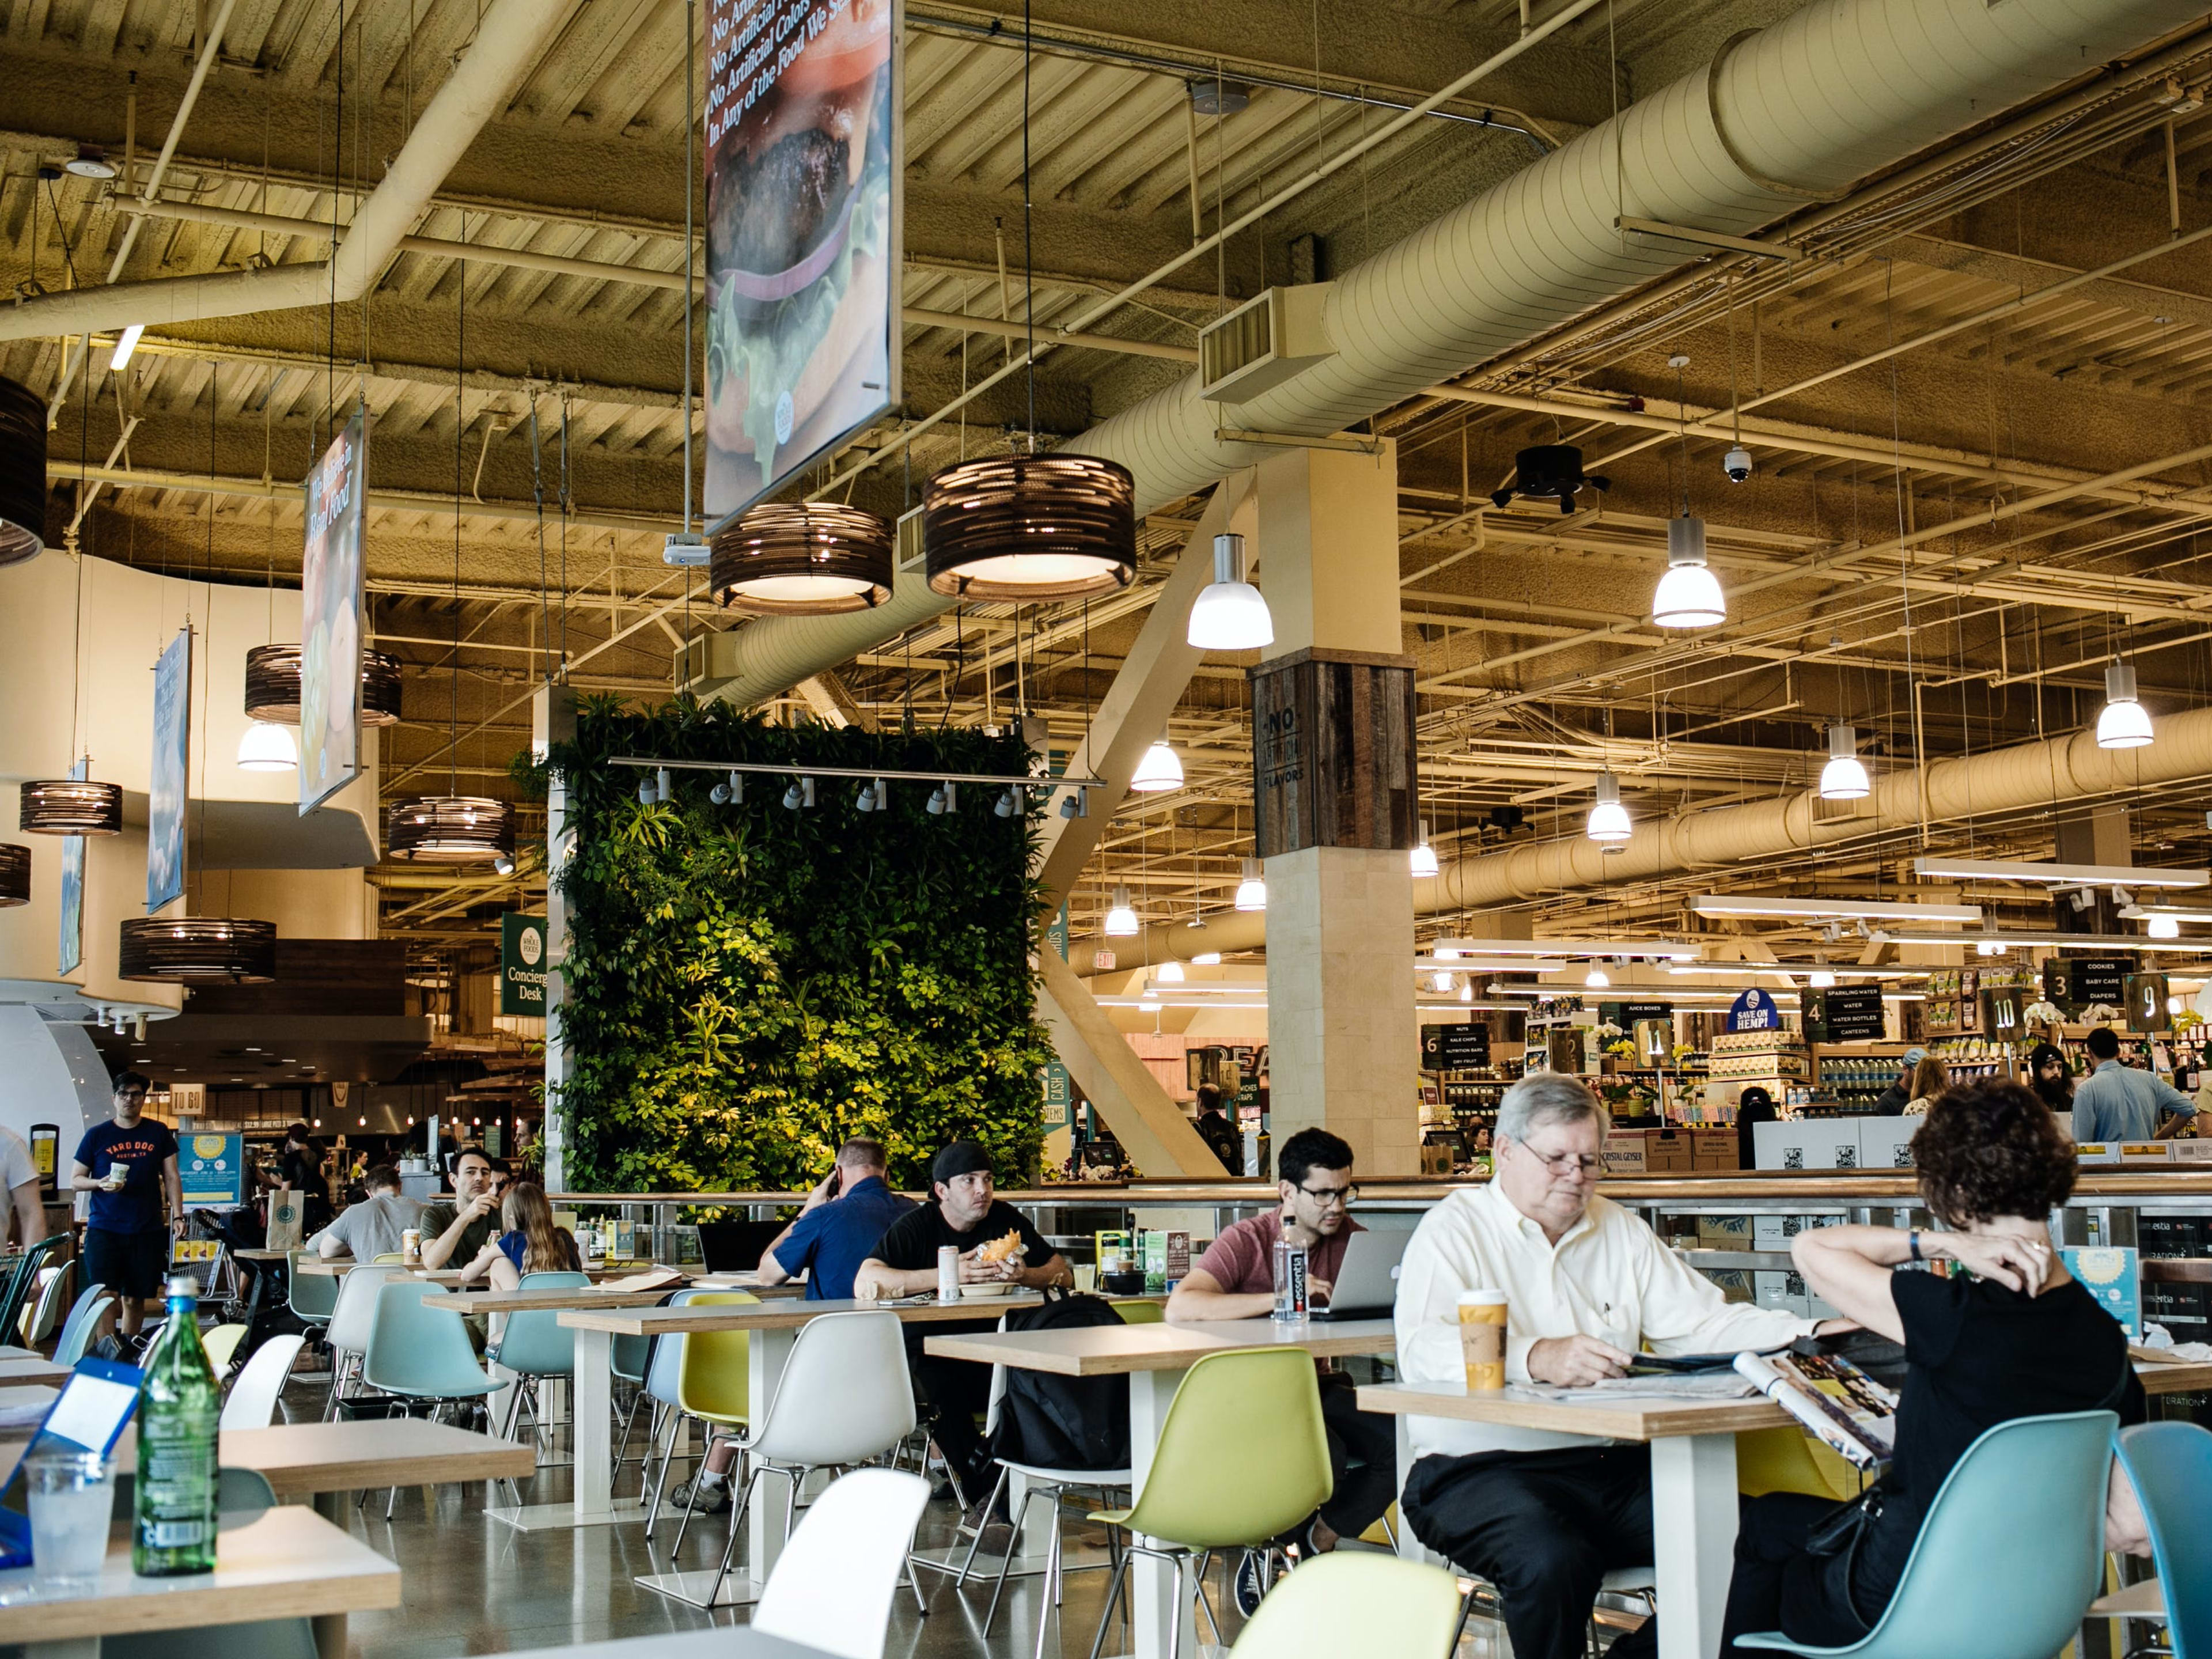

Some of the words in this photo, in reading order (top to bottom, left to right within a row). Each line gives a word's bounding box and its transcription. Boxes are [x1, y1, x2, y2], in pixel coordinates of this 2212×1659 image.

[710, 50, 727, 81] No
[728, 0, 775, 63] Artificial
[711, 17, 729, 47] No
[710, 84, 725, 114] No
[726, 26, 774, 96] Artificial
[775, 0, 810, 43] Colors
[710, 122, 720, 148] In
[721, 98, 744, 135] Any
[745, 77, 757, 109] of
[758, 65, 775, 97] the
[777, 25, 805, 77] Food
[807, 6, 826, 41] We
[312, 476, 323, 503] We
[323, 453, 345, 493] Believe
[344, 441, 352, 466] in
[310, 498, 329, 547] Real
[328, 469, 353, 525] Food
[1269, 707, 1294, 734] NO
[523, 937, 540, 946] WHOLE
[524, 945, 539, 953] FOODS
[1099, 953, 1113, 967] EXIT
[519, 986, 543, 1001] Desk
[2055, 976, 2067, 996] 3
[2144, 986, 2156, 1017] 9
[1737, 1010, 1756, 1020] SAVE
[1757, 1009, 1768, 1018] ON
[1808, 1003, 1821, 1021] 4
[1995, 999, 2015, 1028] 10
[1737, 1017, 1768, 1030] HEMP!
[1427, 1037, 1437, 1052] 6
[1647, 1030, 1664, 1055] 11
[1051, 1077, 1065, 1100] CASH
[175, 1092, 184, 1109] TO
[188, 1092, 200, 1108] GO
[1046, 1107, 1063, 1120] TEMS
[106, 1142, 131, 1154] YARD
[135, 1142, 154, 1152] DOG
[1603, 1152, 1623, 1161] CRYSTAL
[1623, 1152, 1642, 1162] GEYSER
[1293, 1257, 1304, 1300] essentia
